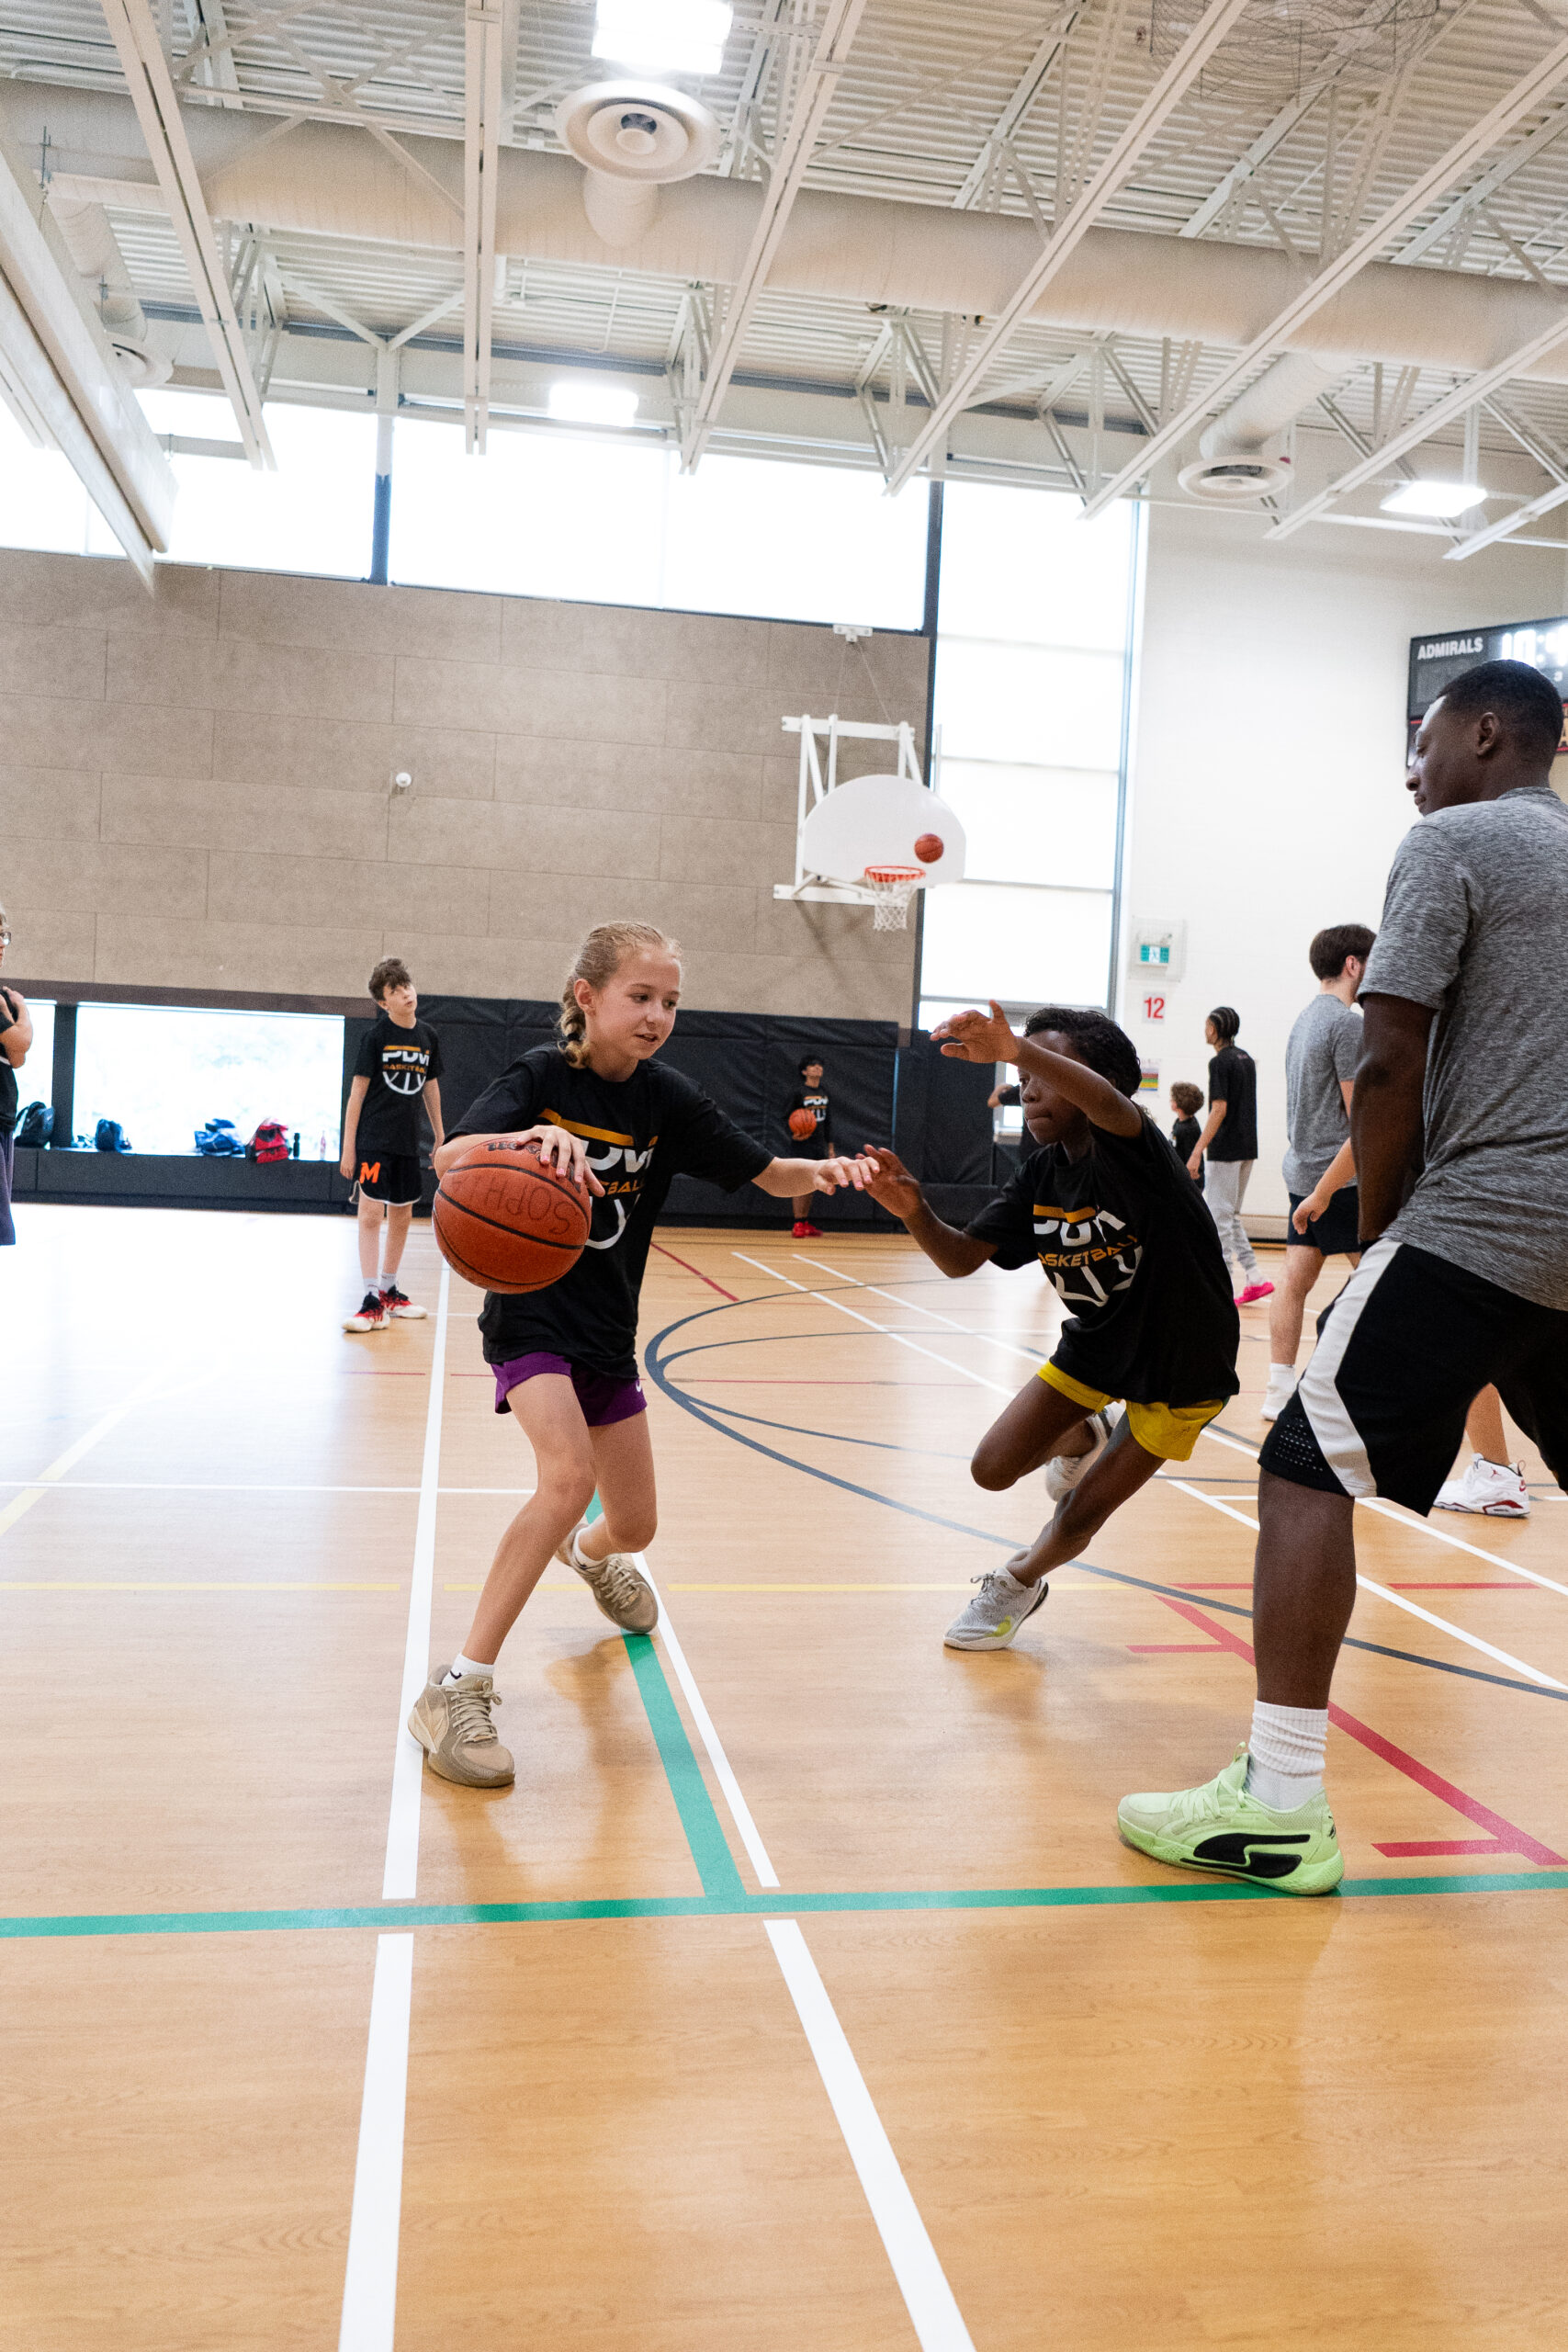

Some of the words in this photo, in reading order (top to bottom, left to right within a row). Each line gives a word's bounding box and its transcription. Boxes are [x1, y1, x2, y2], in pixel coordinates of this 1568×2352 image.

[1417, 637, 1483, 661] ADMIRALS
[1144, 997, 1165, 1019] 12
[360, 1161, 381, 1184] M
